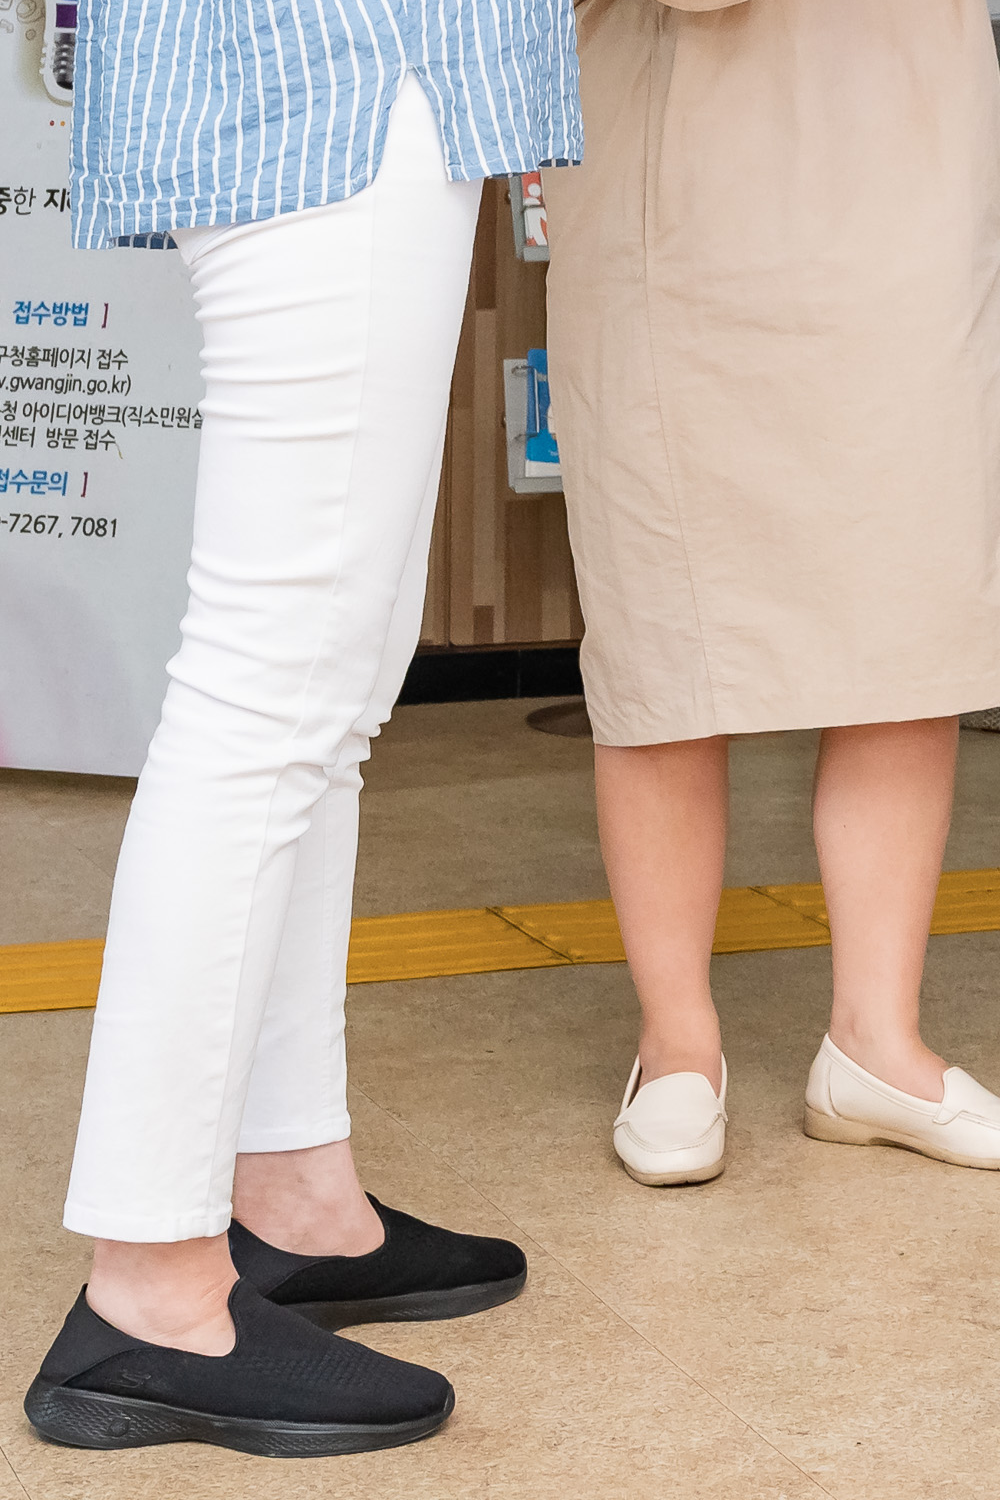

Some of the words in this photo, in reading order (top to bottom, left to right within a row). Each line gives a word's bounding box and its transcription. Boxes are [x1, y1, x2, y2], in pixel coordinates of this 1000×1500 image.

[43, 188, 71, 213] 지
[13, 301, 89, 327] 접수방법
[97, 349, 129, 370] 접수
[0, 425, 36, 448] 센터
[46, 427, 79, 449] 방문
[83, 429, 115, 451] 접수
[71, 516, 118, 538] 7081
